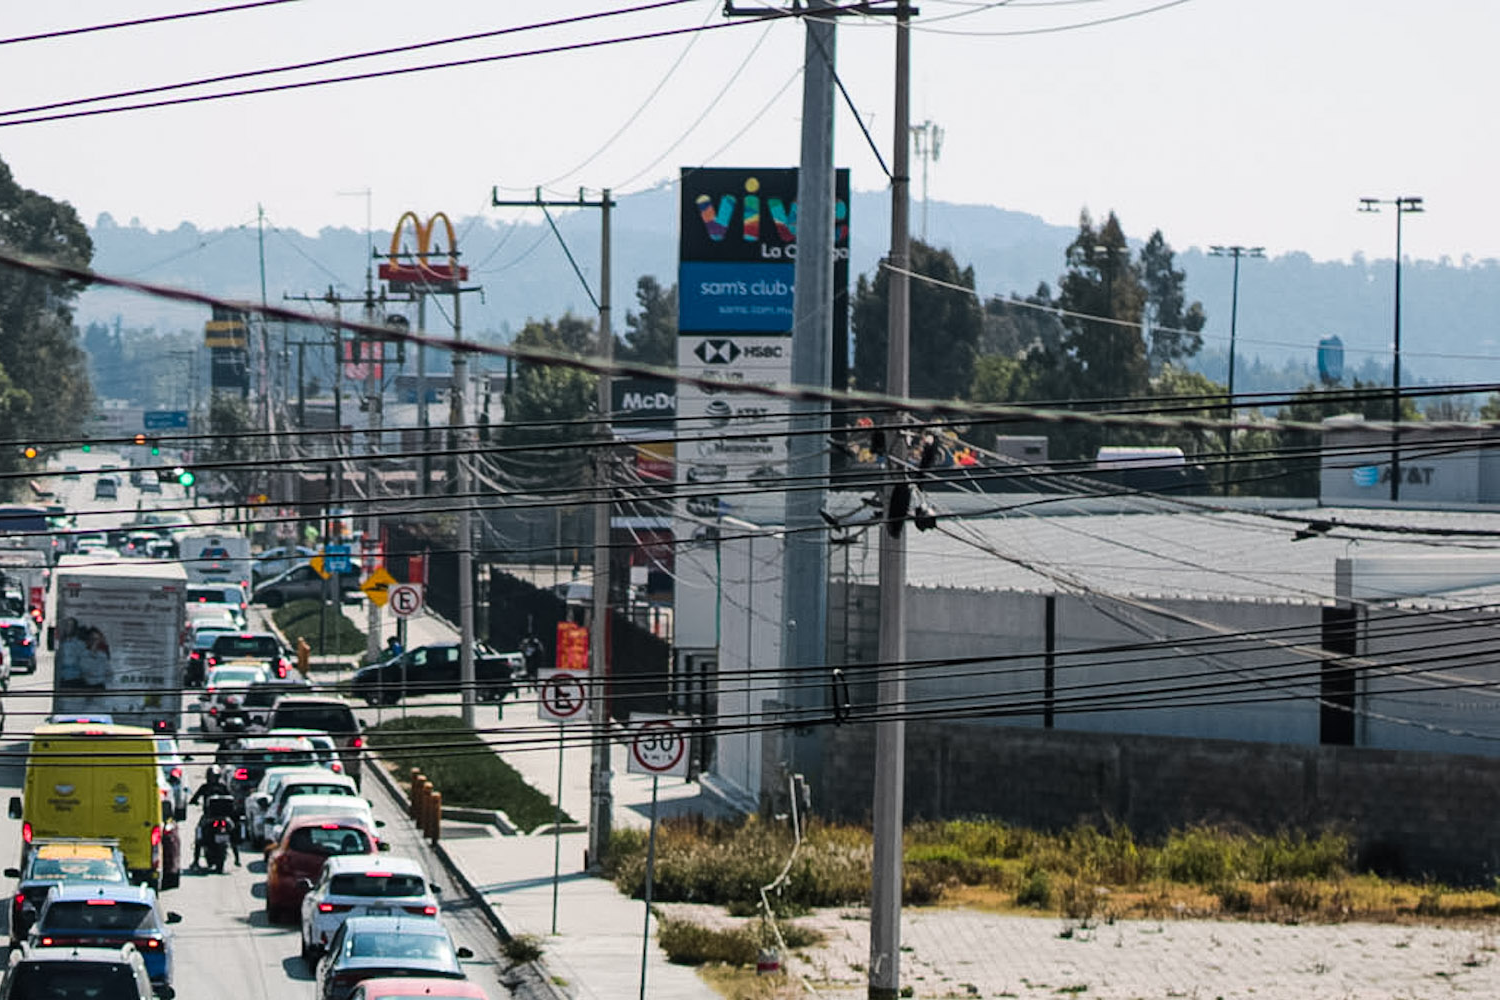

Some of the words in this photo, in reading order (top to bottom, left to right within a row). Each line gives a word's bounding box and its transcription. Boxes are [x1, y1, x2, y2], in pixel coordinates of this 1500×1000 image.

[750, 279, 788, 295] club
[744, 346, 782, 358] HSBC
[400, 592, 410, 609] E
